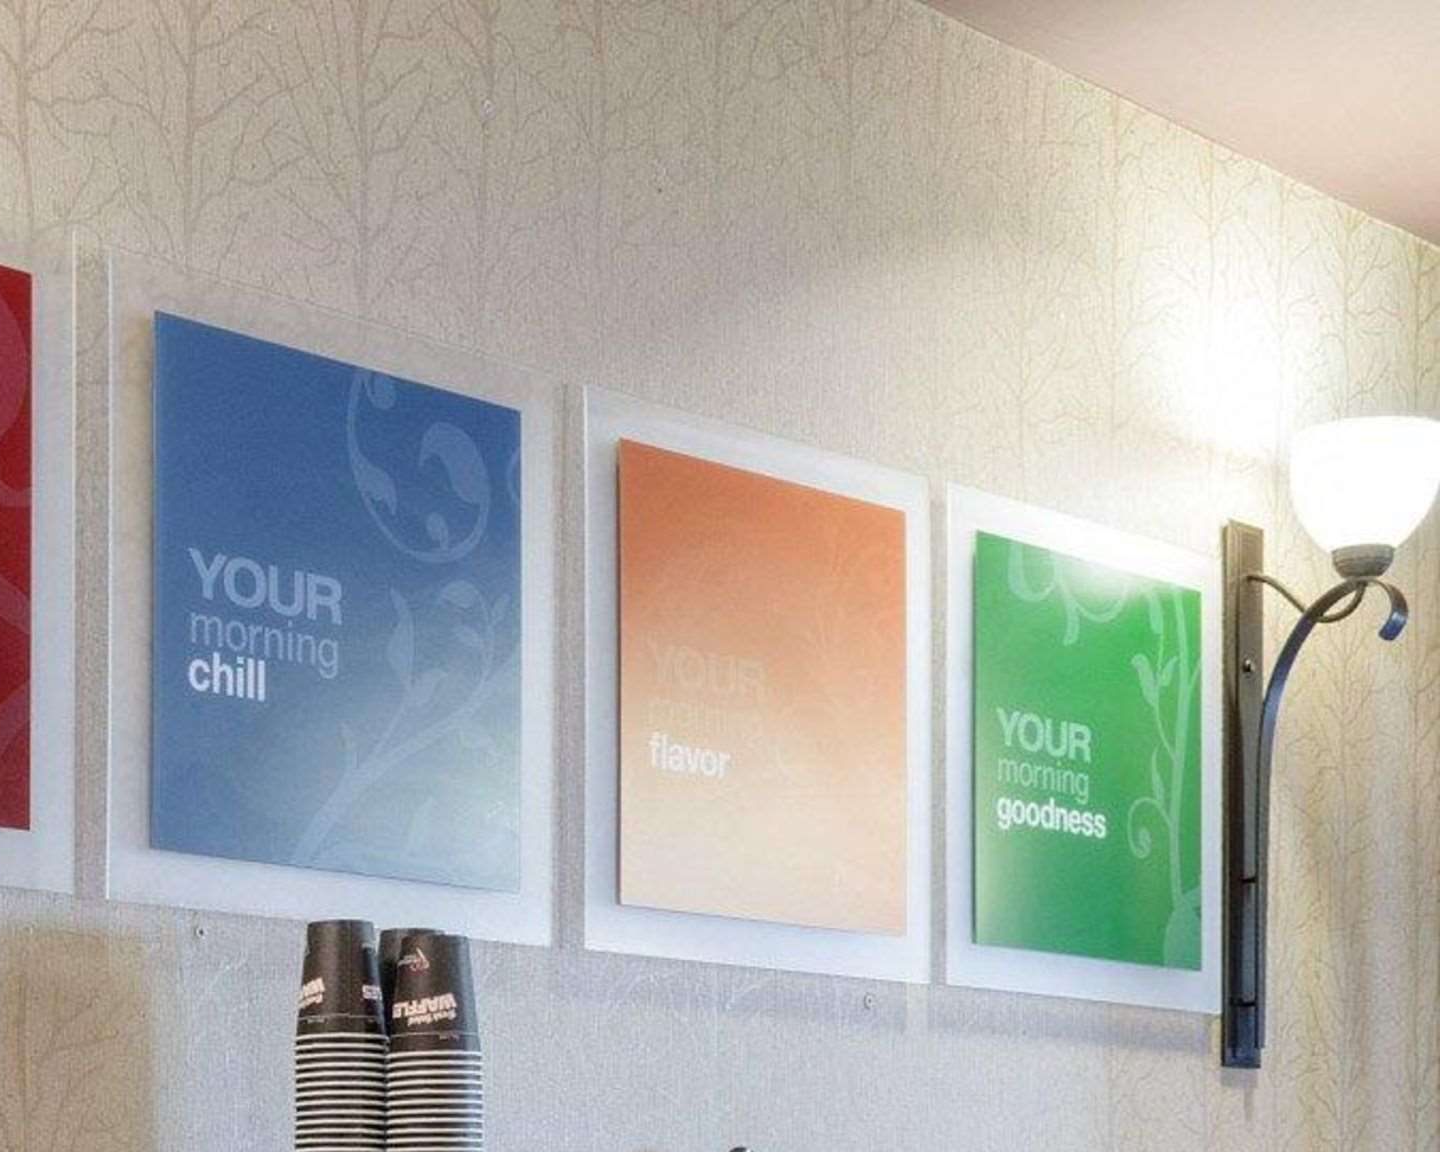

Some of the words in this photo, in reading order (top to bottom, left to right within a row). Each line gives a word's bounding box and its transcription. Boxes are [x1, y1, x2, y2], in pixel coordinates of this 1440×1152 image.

[187, 547, 343, 625] YOUR
[189, 612, 339, 680] morning
[188, 651, 266, 702] chill
[648, 730, 731, 779] flavor
[996, 706, 1092, 763] YOUR
[997, 757, 1089, 805] morning
[996, 796, 1107, 839] goodness
[392, 992, 458, 1019] WAFFLE
